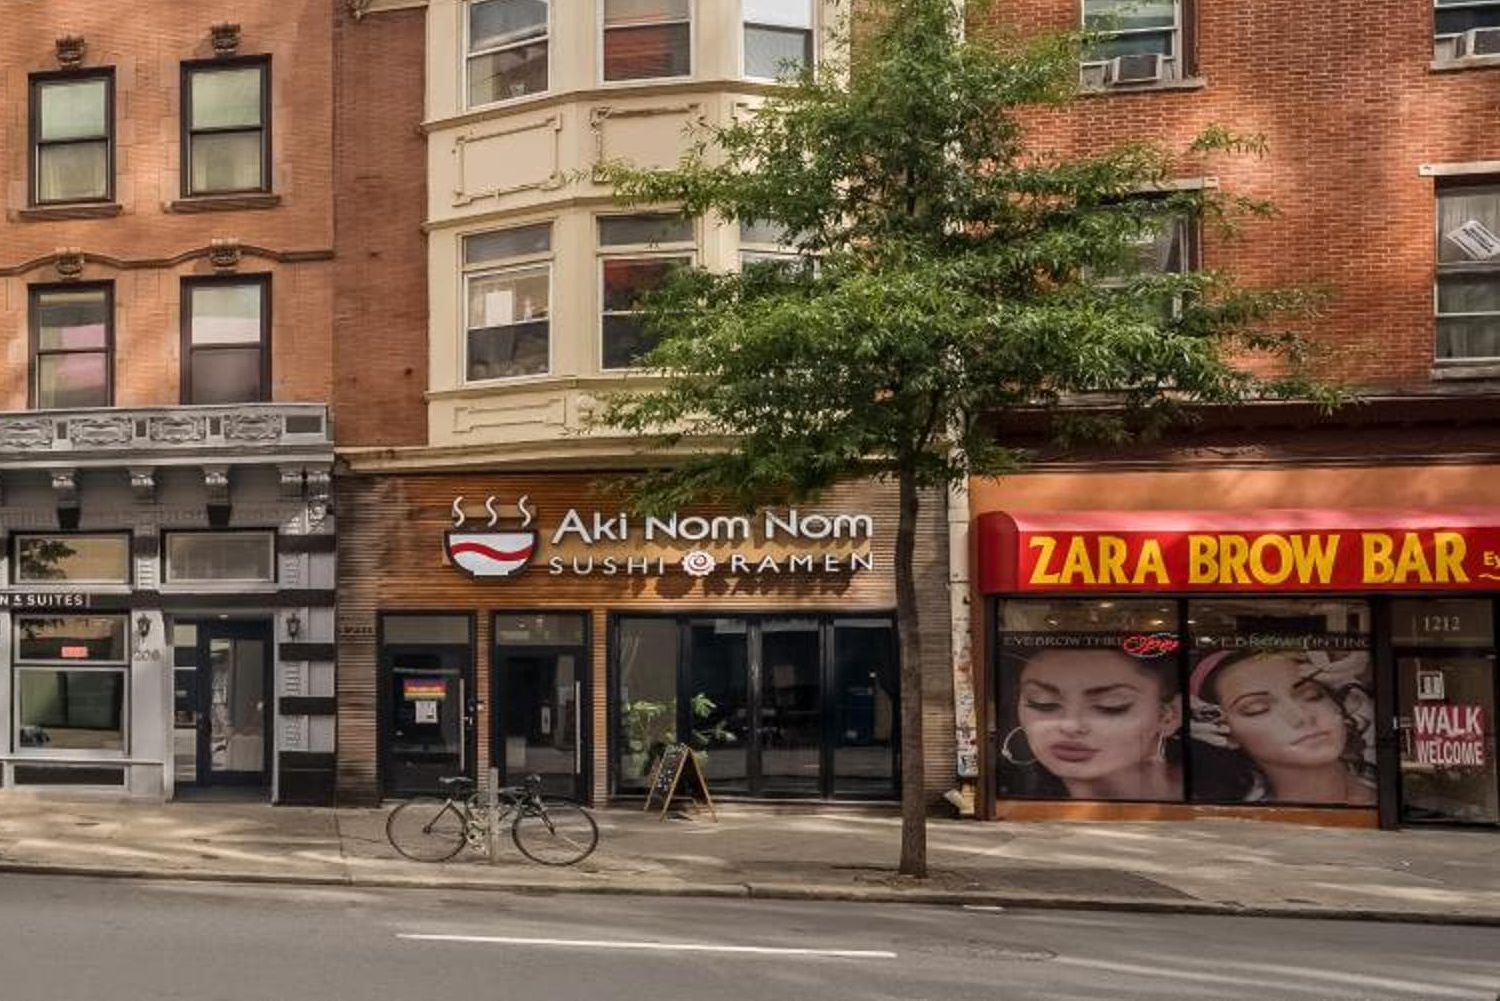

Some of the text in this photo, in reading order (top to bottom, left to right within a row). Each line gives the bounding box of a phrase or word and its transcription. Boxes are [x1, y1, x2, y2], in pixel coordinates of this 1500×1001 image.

[552, 509, 873, 544] Aki Nom Nom
[549, 552, 874, 575] SUSHI RAMEN
[1029, 532, 1470, 584] ZARA BROW BAR
[27, 594, 83, 606] SUITES
[1423, 615, 1461, 631] 1212
[1413, 706, 1483, 736] WALK
[1416, 740, 1484, 765] WELCOME
